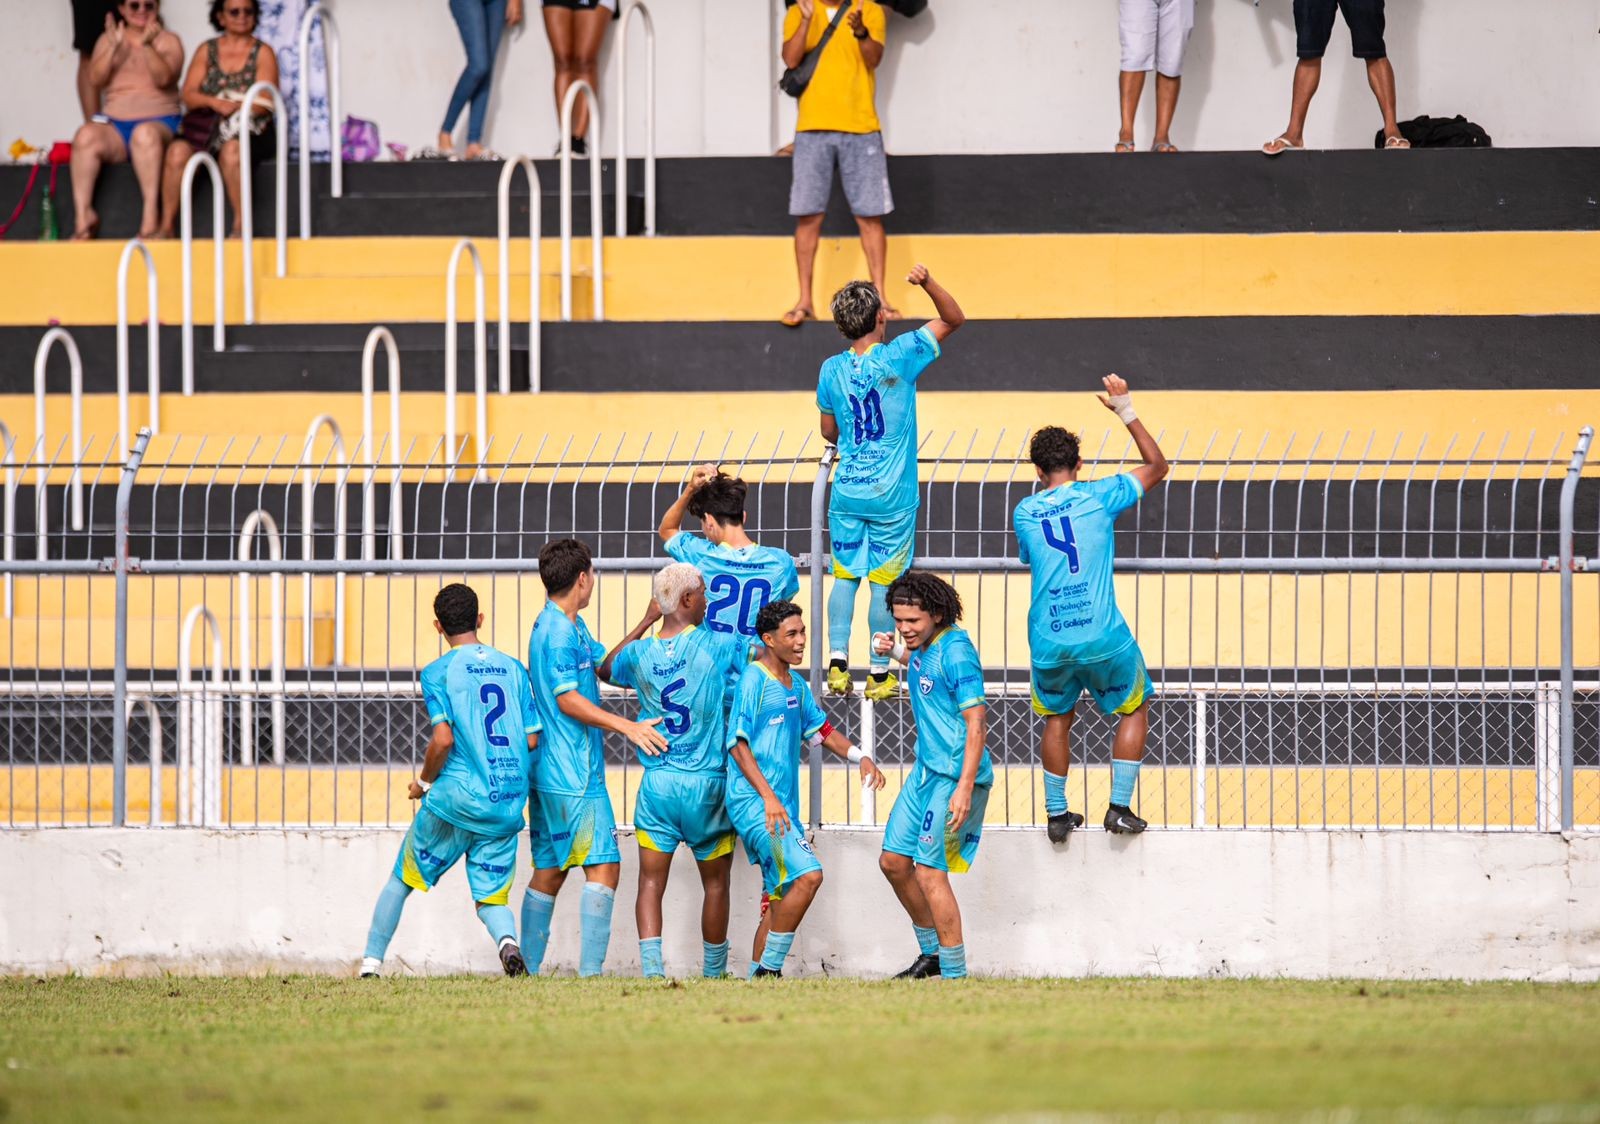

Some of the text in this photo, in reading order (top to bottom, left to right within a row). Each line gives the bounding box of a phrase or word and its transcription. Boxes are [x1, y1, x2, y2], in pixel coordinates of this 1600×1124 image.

[849, 387, 885, 445] 10
[1032, 503, 1072, 519] Saraiva
[1041, 516, 1079, 574] 4
[725, 560, 765, 569] Saraiva
[1063, 582, 1089, 591] RECANTO
[707, 575, 771, 635] 20
[1060, 600, 1092, 611] Soluções
[466, 665, 507, 674] Saraiva
[653, 659, 687, 676] Saraiva
[480, 683, 510, 747] 2
[661, 678, 691, 735] 5
[922, 810, 934, 832] 8
